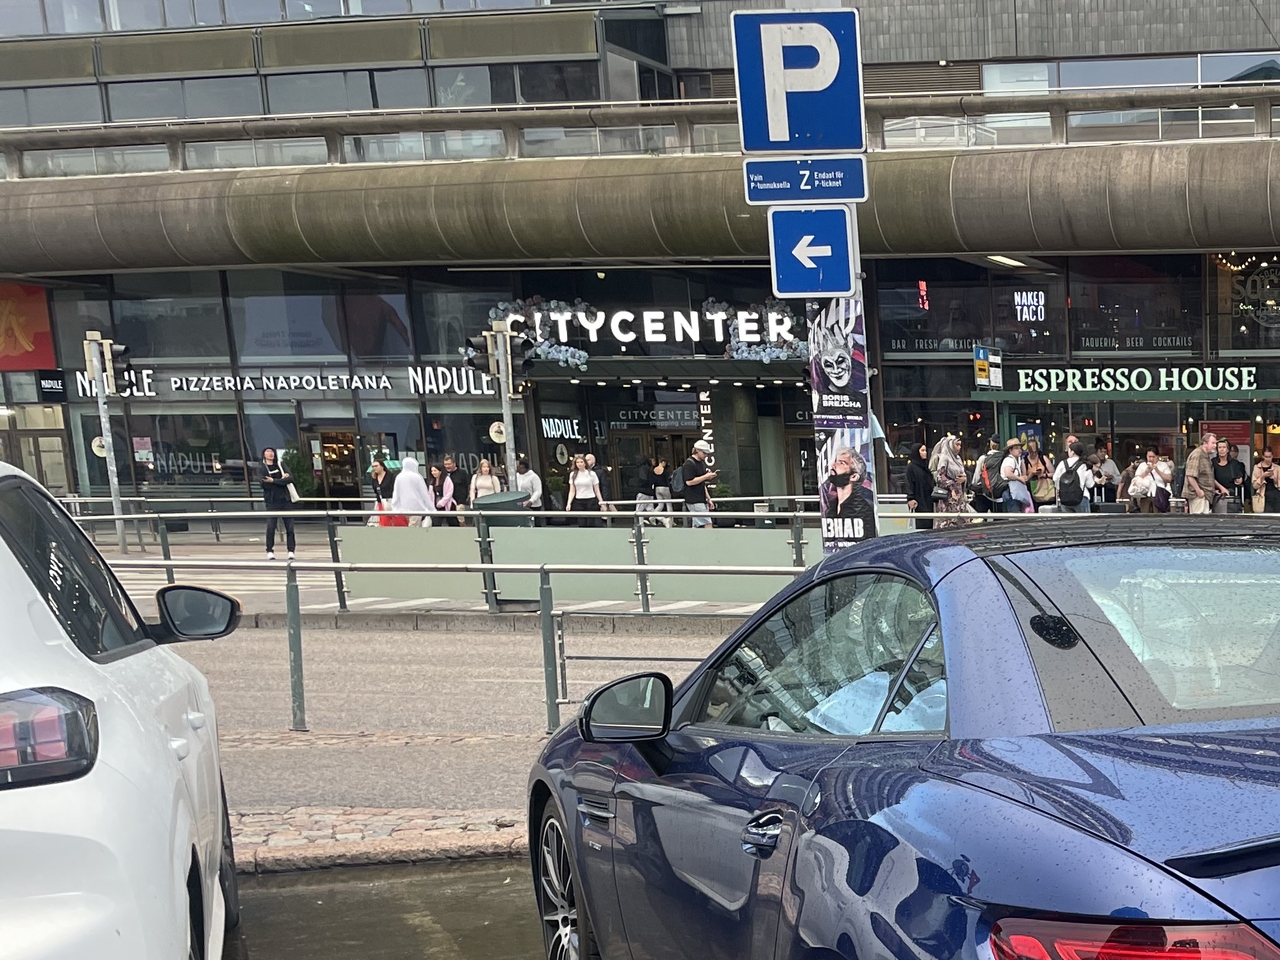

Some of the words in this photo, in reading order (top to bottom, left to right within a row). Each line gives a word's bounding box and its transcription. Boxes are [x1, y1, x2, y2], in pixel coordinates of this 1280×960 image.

[760, 22, 840, 142] P
[799, 170, 812, 190] Z
[814, 171, 834, 180] Endast
[835, 171, 844, 179] för
[750, 182, 791, 190] P-tunnuksella
[1014, 290, 1045, 306] NAKED
[1015, 305, 1045, 322] TACO
[891, 339, 907, 350] BAR
[915, 339, 938, 350] FRESH
[1082, 337, 1116, 347] TAQUERIA
[1126, 337, 1144, 347] BEER
[1152, 336, 1192, 347] COCKTAILS
[171, 376, 256, 391] PIZZERIA
[262, 375, 392, 390] NAPOLETANA
[408, 366, 496, 395] NAPULE
[1018, 368, 1152, 392] ESPRESSO
[1158, 367, 1257, 391] HOUSE
[619, 410, 700, 420] CITYCENTER
[541, 418, 581, 439] NAPULE
[156, 452, 222, 474] NAPULE
